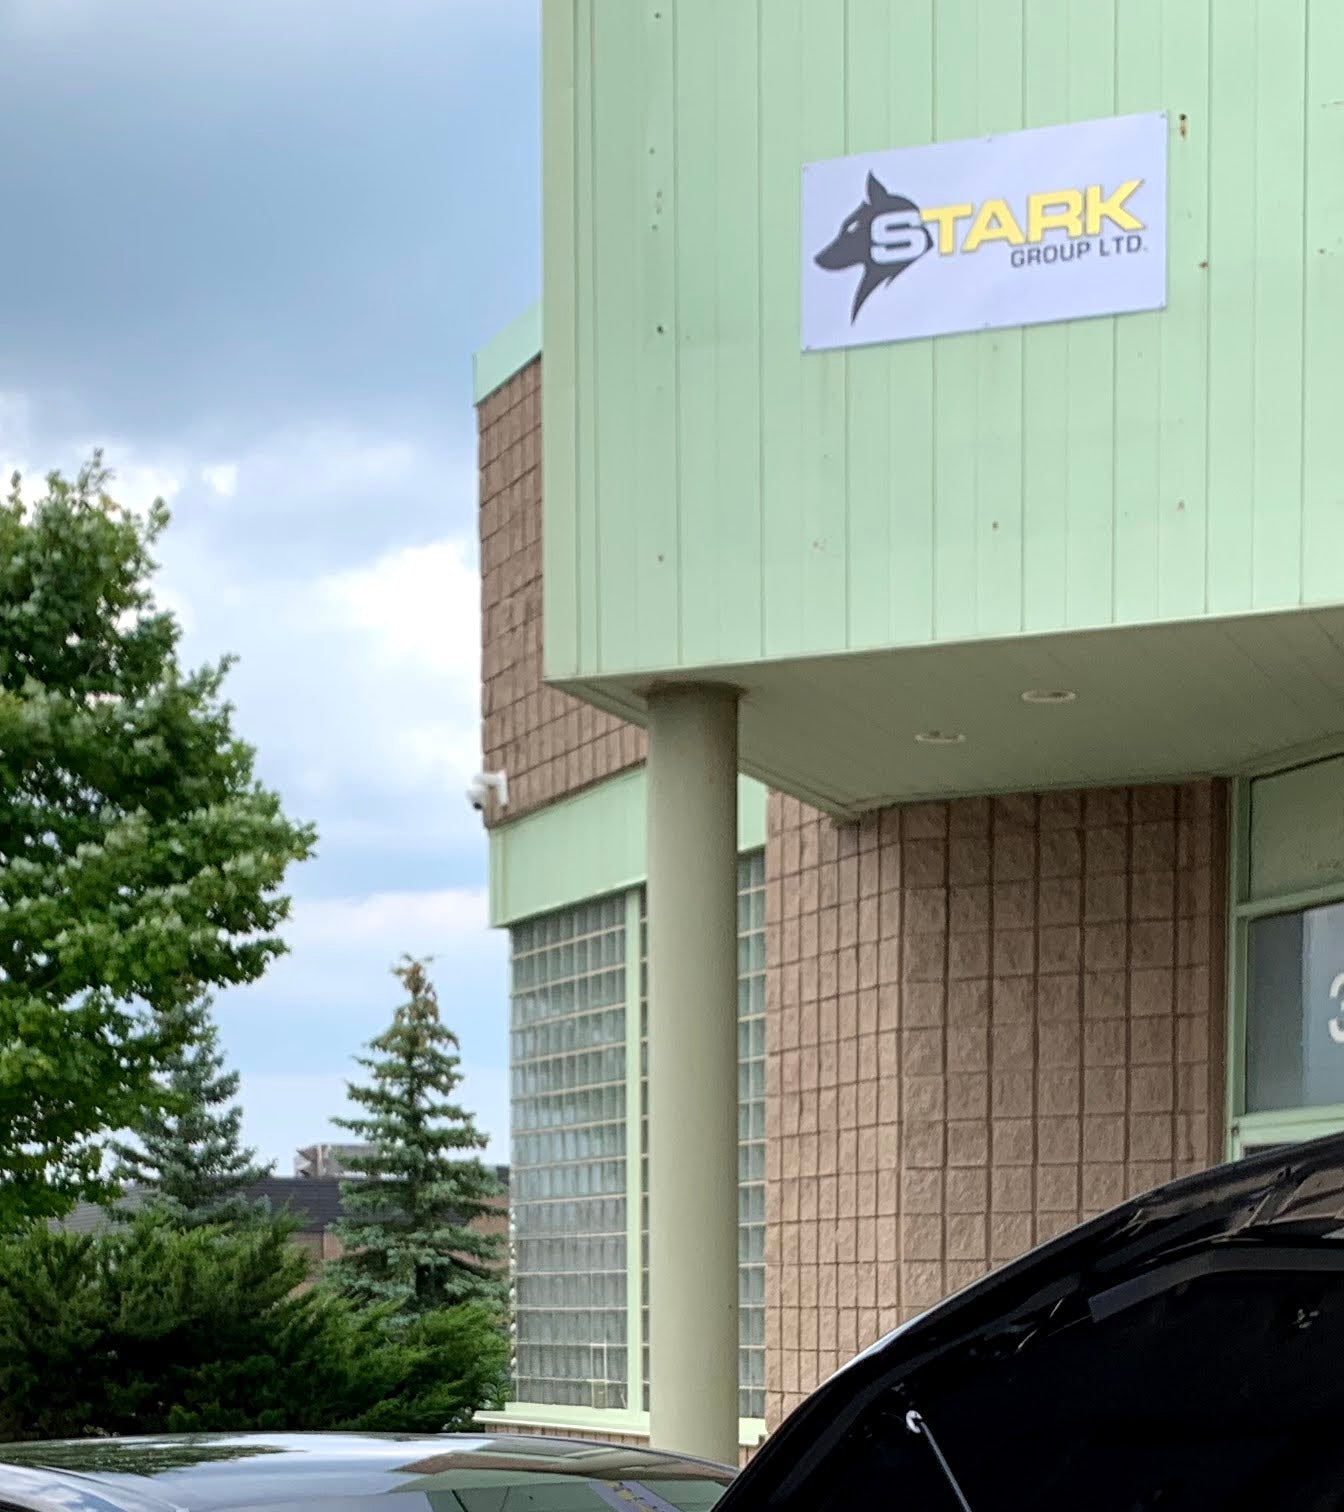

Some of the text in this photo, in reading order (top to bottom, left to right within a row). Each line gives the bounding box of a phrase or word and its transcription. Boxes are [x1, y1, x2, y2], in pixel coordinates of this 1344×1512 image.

[869, 178, 1146, 266] STARK
[1010, 234, 1149, 268] GROUP LTD.
